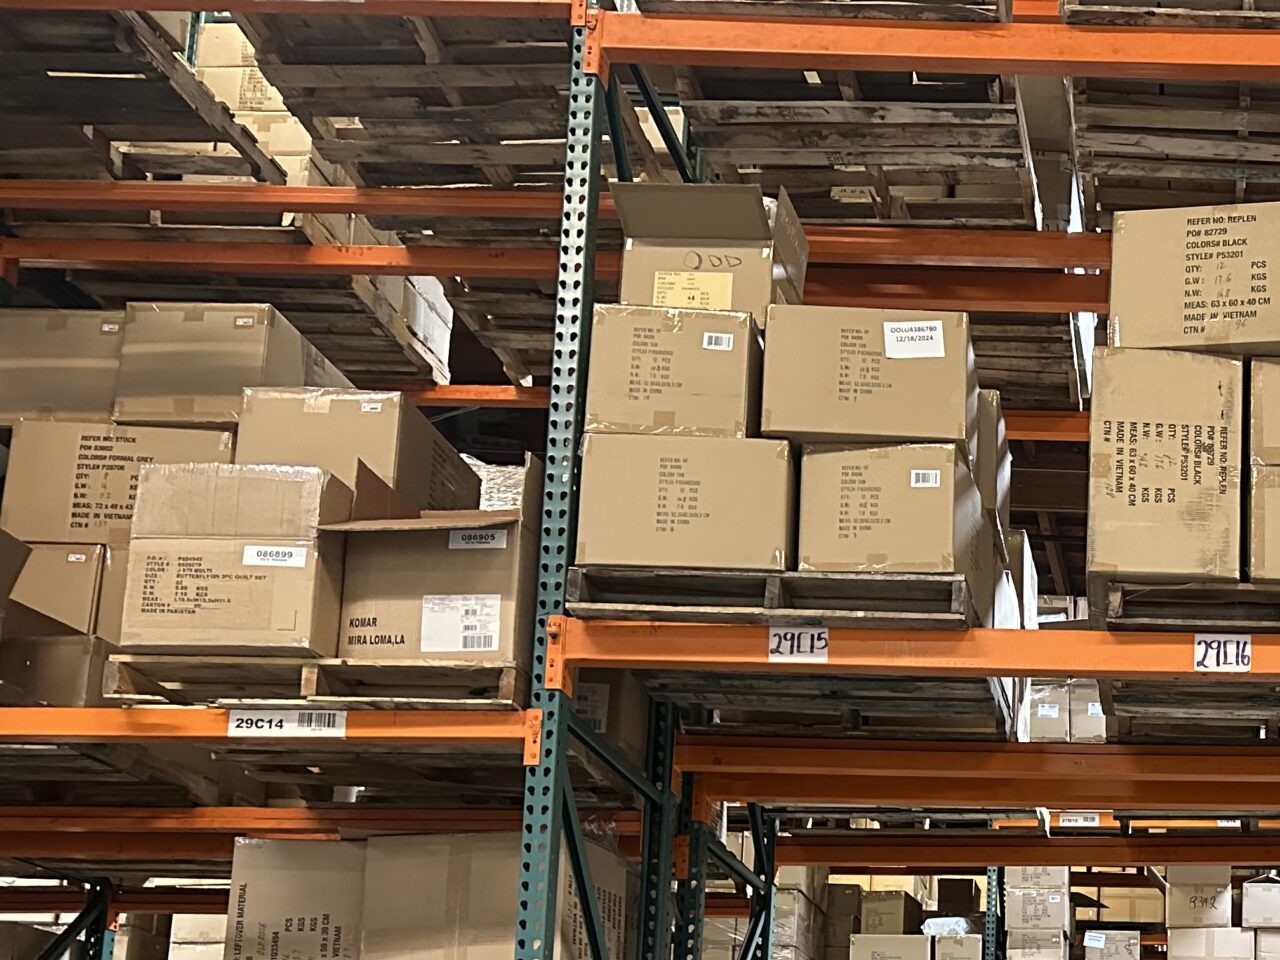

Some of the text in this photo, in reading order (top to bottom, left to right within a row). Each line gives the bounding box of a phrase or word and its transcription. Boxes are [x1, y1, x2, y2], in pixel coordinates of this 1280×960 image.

[1184, 313, 1205, 321] MADE
[1223, 311, 1256, 319] VIETNAM
[1129, 448, 1136, 457] 63
[1129, 465, 1136, 475] 60
[1129, 483, 1136, 492] 40
[1128, 494, 1136, 506] CM
[257, 550, 293, 559] 086899
[349, 618, 377, 627] KOMAR
[348, 635, 367, 645] MIRA
[235, 718, 284, 729] 29C14
